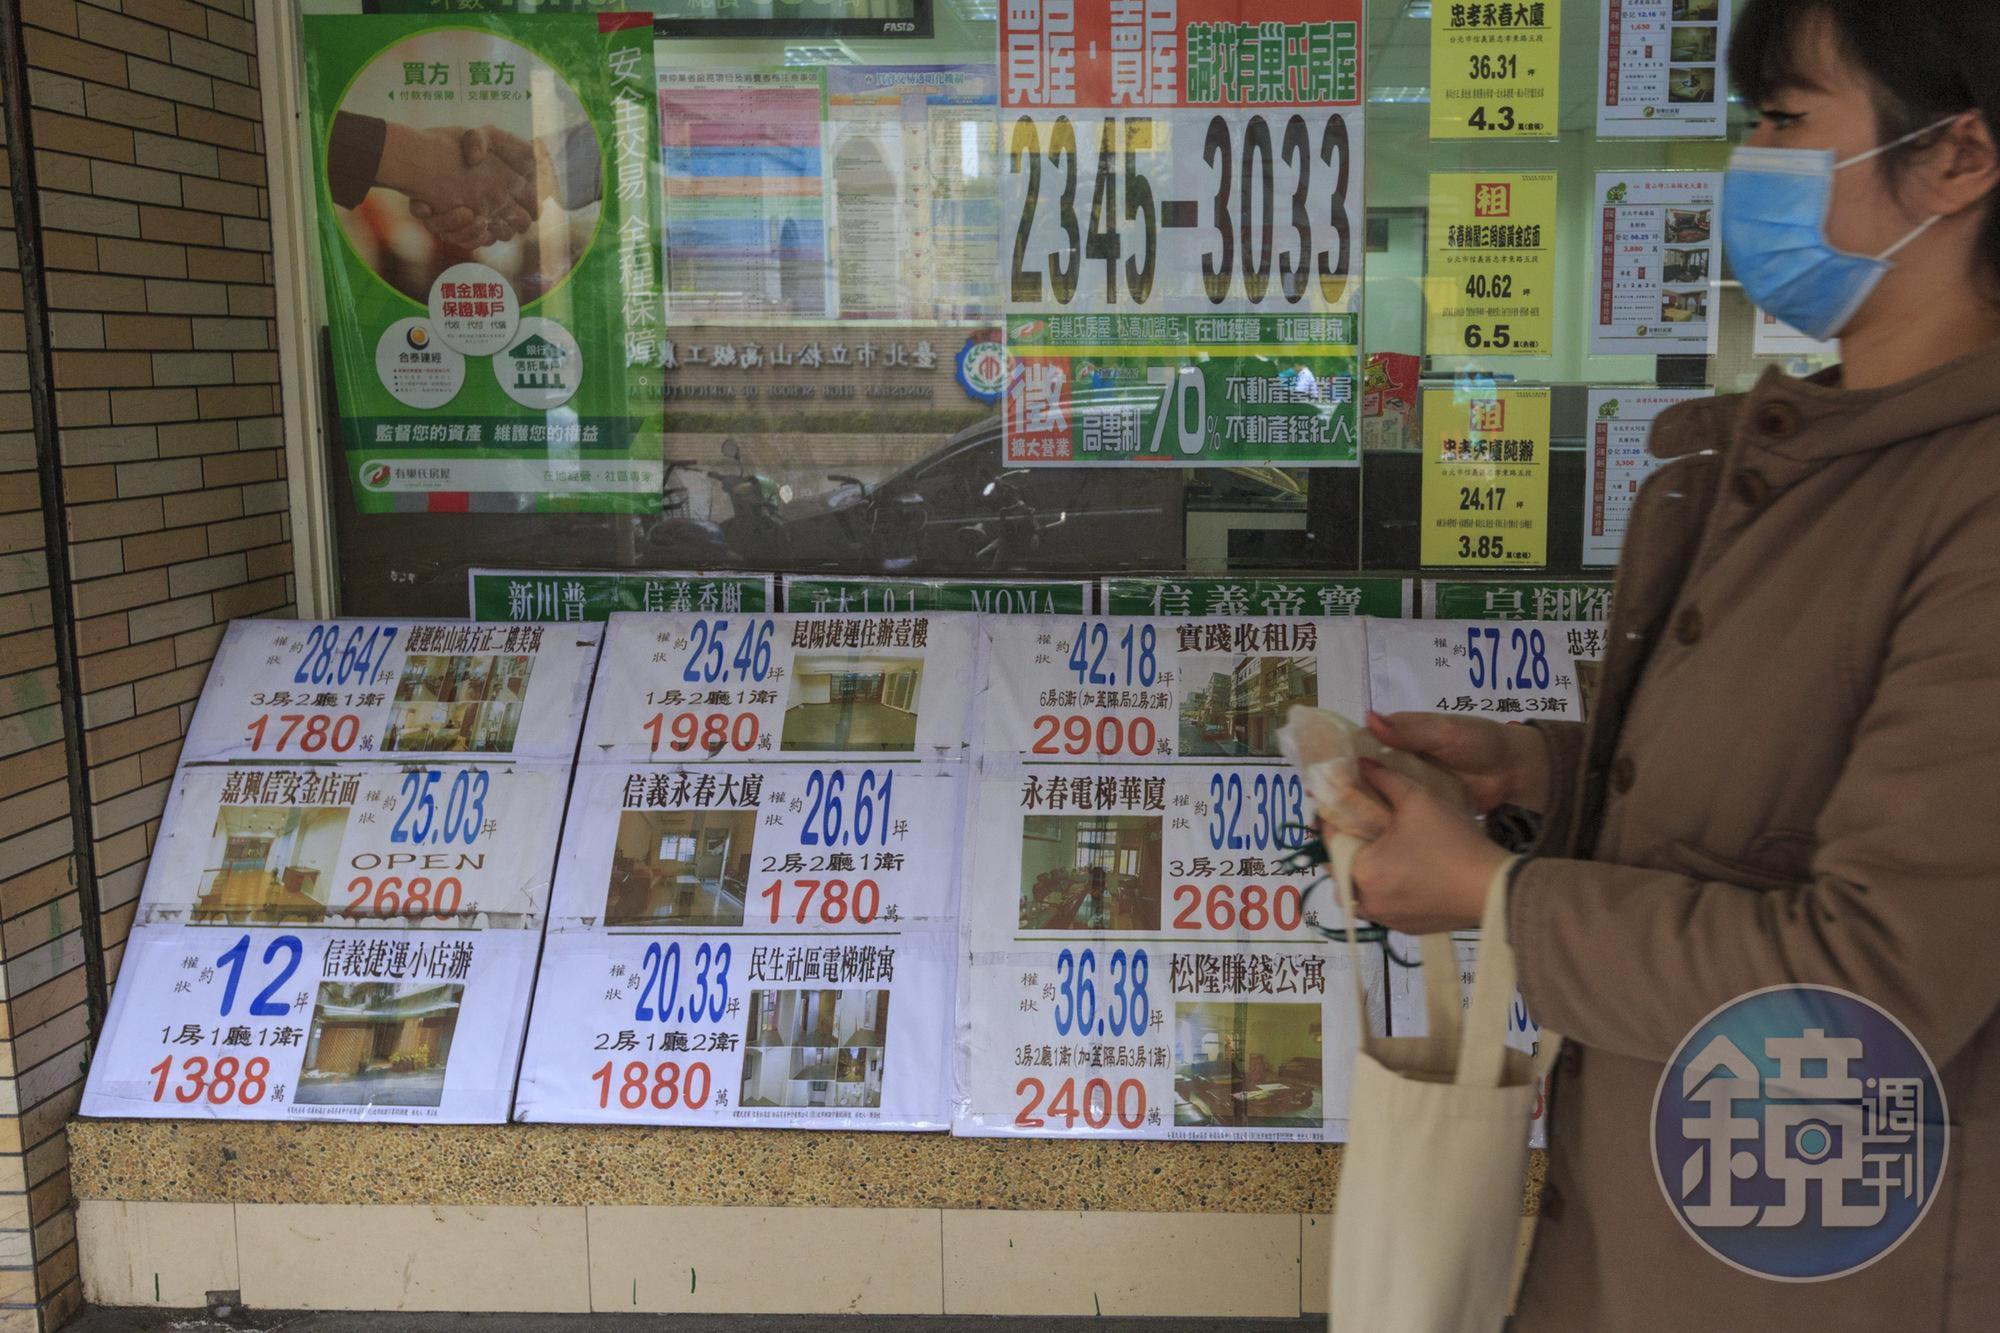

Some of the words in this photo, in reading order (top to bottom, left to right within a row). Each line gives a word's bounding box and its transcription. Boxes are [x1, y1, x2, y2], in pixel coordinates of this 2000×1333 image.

[1451, 2, 1545, 28] 忠孝永春大廈
[403, 62, 450, 86] 買方
[468, 62, 515, 86] 賣方
[1186, 21, 1358, 103] 請找有巢氏房屋
[1469, 54, 1517, 80] 36.31
[608, 46, 648, 201] 安全交易
[1468, 106, 1515, 131] 4.3
[1010, 114, 1351, 304] 2345-3033
[1476, 184, 1510, 216] 租
[440, 282, 504, 299] 價金履約
[617, 215, 658, 367] 全程保障
[1465, 274, 1513, 298] 40.62
[442, 301, 505, 318] 保證專戶
[1047, 316, 1111, 339] 有巢氏房屋
[1117, 316, 1181, 339] 松高加盟店
[1464, 324, 1511, 348] 6.5
[514, 360, 561, 373] 信託專戶
[1008, 362, 1068, 434] 徵
[1226, 376, 1353, 404] 不動產營業員
[375, 424, 482, 442] 監督您的資產
[494, 423, 599, 443] 維護您的權益
[1226, 415, 1353, 444] 不動產經紀人
[1010, 438, 1071, 458] 擴大營業
[1460, 487, 1506, 511] 24.17
[1458, 535, 1503, 558] 3.85
[508, 580, 588, 621] 新川普
[970, 589, 1056, 614] MOMA
[1149, 584, 1362, 616] 信義帝寶
[683, 618, 775, 683] 25.46
[767, 666, 785, 680] 坪
[791, 618, 929, 649] 昆陽捷運住辦壹樓
[1176, 622, 1318, 653] 實踐收租房
[1568, 627, 1609, 658] 忠孝
[294, 624, 399, 686] 28.647
[378, 671, 395, 683] 坪
[1068, 622, 1157, 688] 42.18
[1157, 671, 1175, 687] 坪
[1467, 627, 1550, 690] 57.28
[1555, 674, 1572, 688] 坪
[250, 691, 387, 707] 3房2廳1衛
[646, 690, 779, 706] 1房2廳1衛
[1436, 695, 1569, 713] 4房2廳3衛
[247, 713, 361, 752] 1780
[359, 734, 374, 751] 萬
[643, 711, 760, 753] 1980
[757, 734, 772, 751] 萬
[1031, 714, 1157, 757] 2900
[1157, 737, 1172, 755] 萬
[218, 770, 362, 806] 嘉興信安金店面
[622, 773, 765, 809] 信義永春大廈
[1021, 774, 1167, 812] 永春電梯華廈
[391, 769, 490, 845] 25.03
[480, 818, 497, 840] 坪
[800, 769, 894, 847] 26.61
[892, 819, 909, 841] 坪
[1209, 772, 1304, 852] 32.303
[351, 852, 486, 871] OPEN
[761, 852, 906, 873] 2房2廳1衛
[345, 876, 463, 921] 2680
[463, 901, 479, 917] 萬
[760, 878, 881, 925] 1780
[884, 904, 899, 923] 萬
[1172, 884, 1302, 931] 2680
[1304, 910, 1320, 929] 萬
[216, 933, 304, 1018] 12
[293, 992, 310, 1010] 坪
[321, 938, 475, 981] 信義捷運小店辦
[748, 946, 896, 983] 民生社區電梯雅寓
[1168, 953, 1326, 996] 松隆賺錢公寓
[635, 941, 732, 1024] 20.33
[726, 996, 741, 1020] 坪
[1054, 948, 1150, 1038] 36.38
[1149, 1010, 1165, 1033] 坪
[161, 1024, 304, 1047] 1房1廳1衛
[594, 1030, 740, 1053] 2房1廳2衛
[149, 1054, 271, 1105] 1388
[271, 1083, 286, 1103] 萬
[591, 1060, 712, 1110] 1880
[715, 1089, 730, 1108] 萬
[1014, 1077, 1147, 1130] 2400
[1146, 1106, 1161, 1127] 萬
